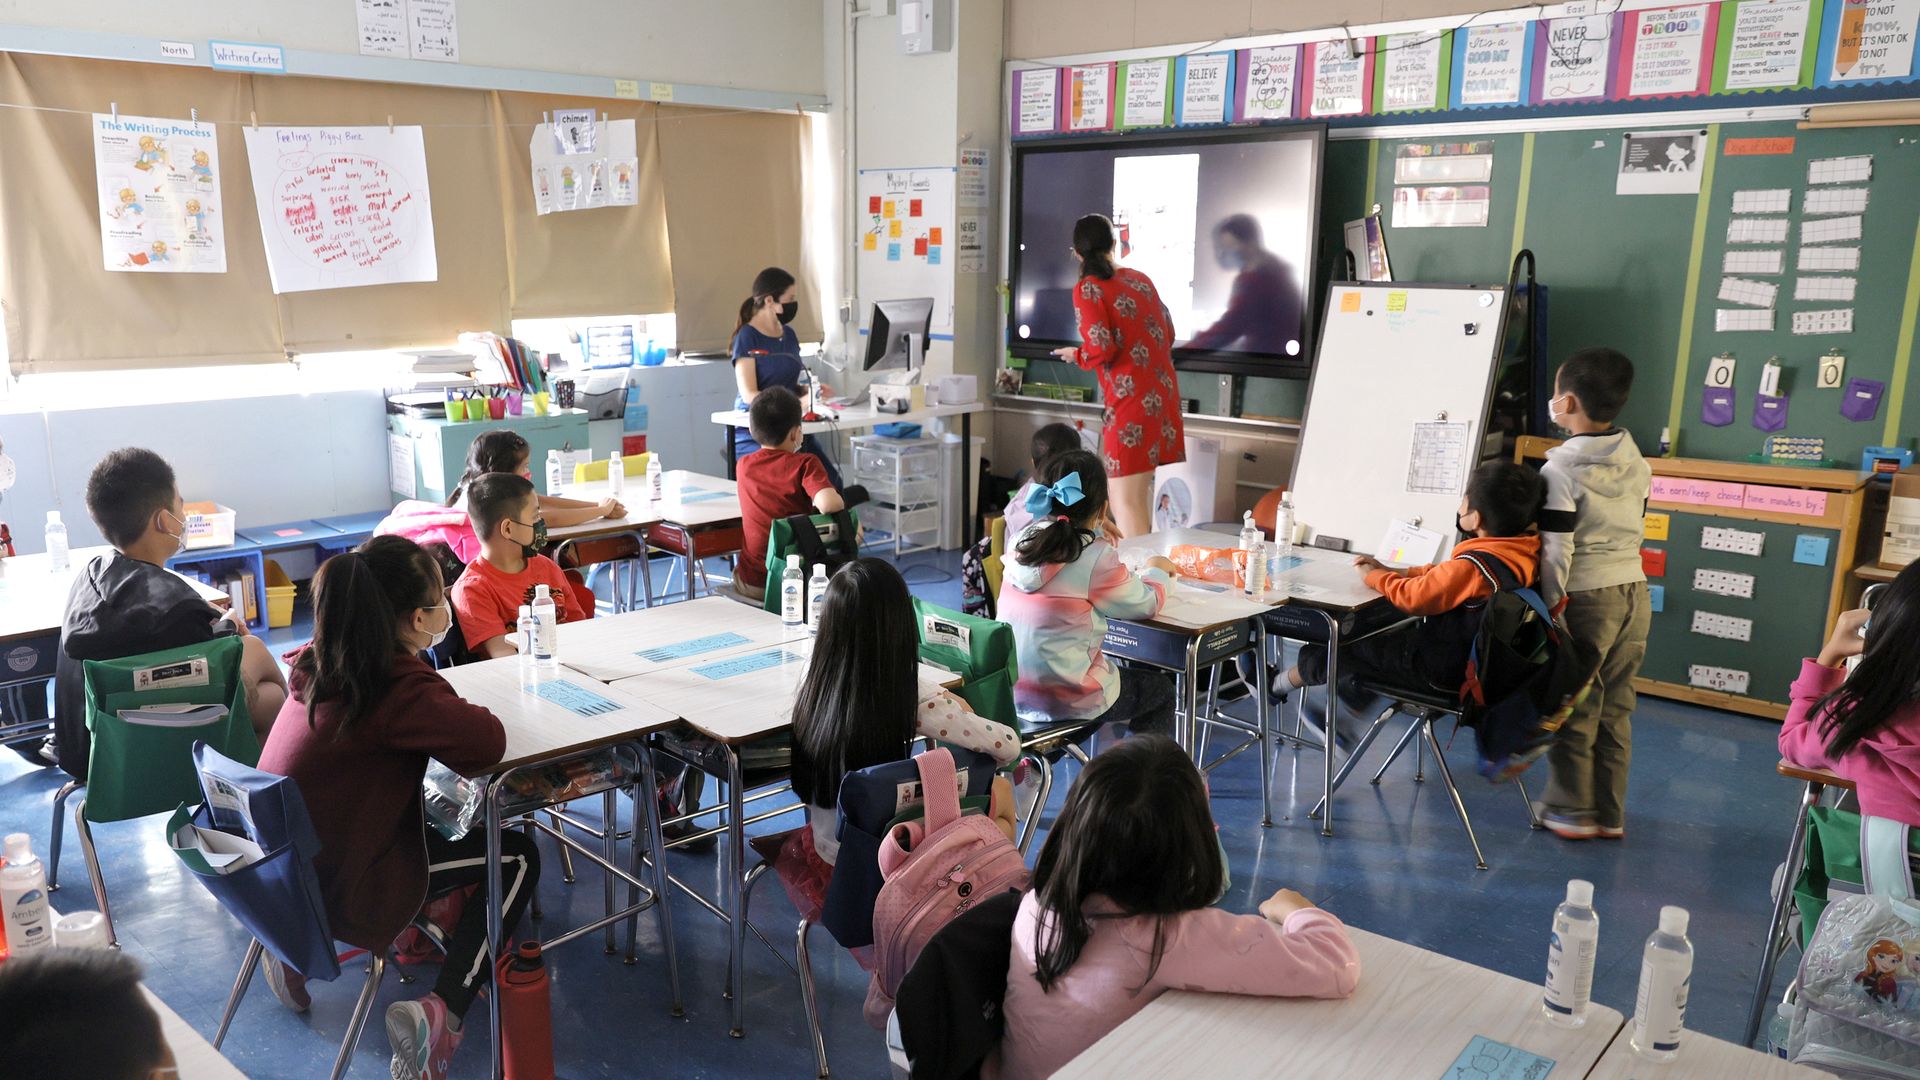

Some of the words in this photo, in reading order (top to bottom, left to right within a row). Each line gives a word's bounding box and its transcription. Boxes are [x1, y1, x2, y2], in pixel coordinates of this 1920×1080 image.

[1566, 5, 1586, 14] East
[1646, 14, 1667, 22] BEFORE
[1667, 12, 1679, 20] YOU
[1679, 10, 1697, 18] SPEAK
[1865, 7, 1876, 16] TO
[1877, 5, 1895, 16] NOT
[1853, 20, 1900, 34] know,
[1552, 26, 1588, 43] NEVER
[1842, 38, 1857, 48] BUT
[1859, 36, 1876, 46] IT'S
[1877, 34, 1895, 45] NOT
[1896, 32, 1909, 43] OK
[1469, 38, 1495, 48] It's
[162, 46, 188, 55] North
[214, 48, 250, 65] Writing
[251, 51, 280, 65] Center
[1467, 50, 1491, 64] GOOD
[1551, 46, 1579, 60] stop
[1859, 49, 1869, 59] TO
[1870, 48, 1888, 58] NOT
[1253, 54, 1292, 63] Mistakes
[1188, 67, 1218, 80] BELIEVE
[1251, 67, 1267, 76] are
[1270, 63, 1290, 74] PROOF
[1467, 69, 1478, 77] to
[1479, 67, 1503, 76] have
[1549, 69, 1600, 81] questions
[1859, 62, 1886, 76] try.
[1147, 72, 1160, 80] you
[1251, 77, 1269, 85] that
[1271, 77, 1288, 87] you
[1337, 74, 1358, 82] when
[1260, 86, 1277, 95] are
[1465, 79, 1488, 93] GOOD
[1136, 94, 1148, 102] you
[100, 120, 122, 132] The
[123, 122, 170, 136] Writing
[171, 126, 212, 138] Process
[276, 131, 312, 143] Feelings
[320, 130, 342, 146] Piggy
[887, 172, 908, 190] Mystery
[960, 221, 977, 232] NEVER
[1715, 366, 1729, 385] 0
[1824, 364, 1839, 385] 0
[1651, 480, 1665, 495] We
[1716, 491, 1743, 501] choice
[1769, 496, 1801, 508] minutes
[1207, 633, 1238, 649] HAMMERMILL
[1693, 668, 1746, 682] clean
[1709, 679, 1727, 689] up
